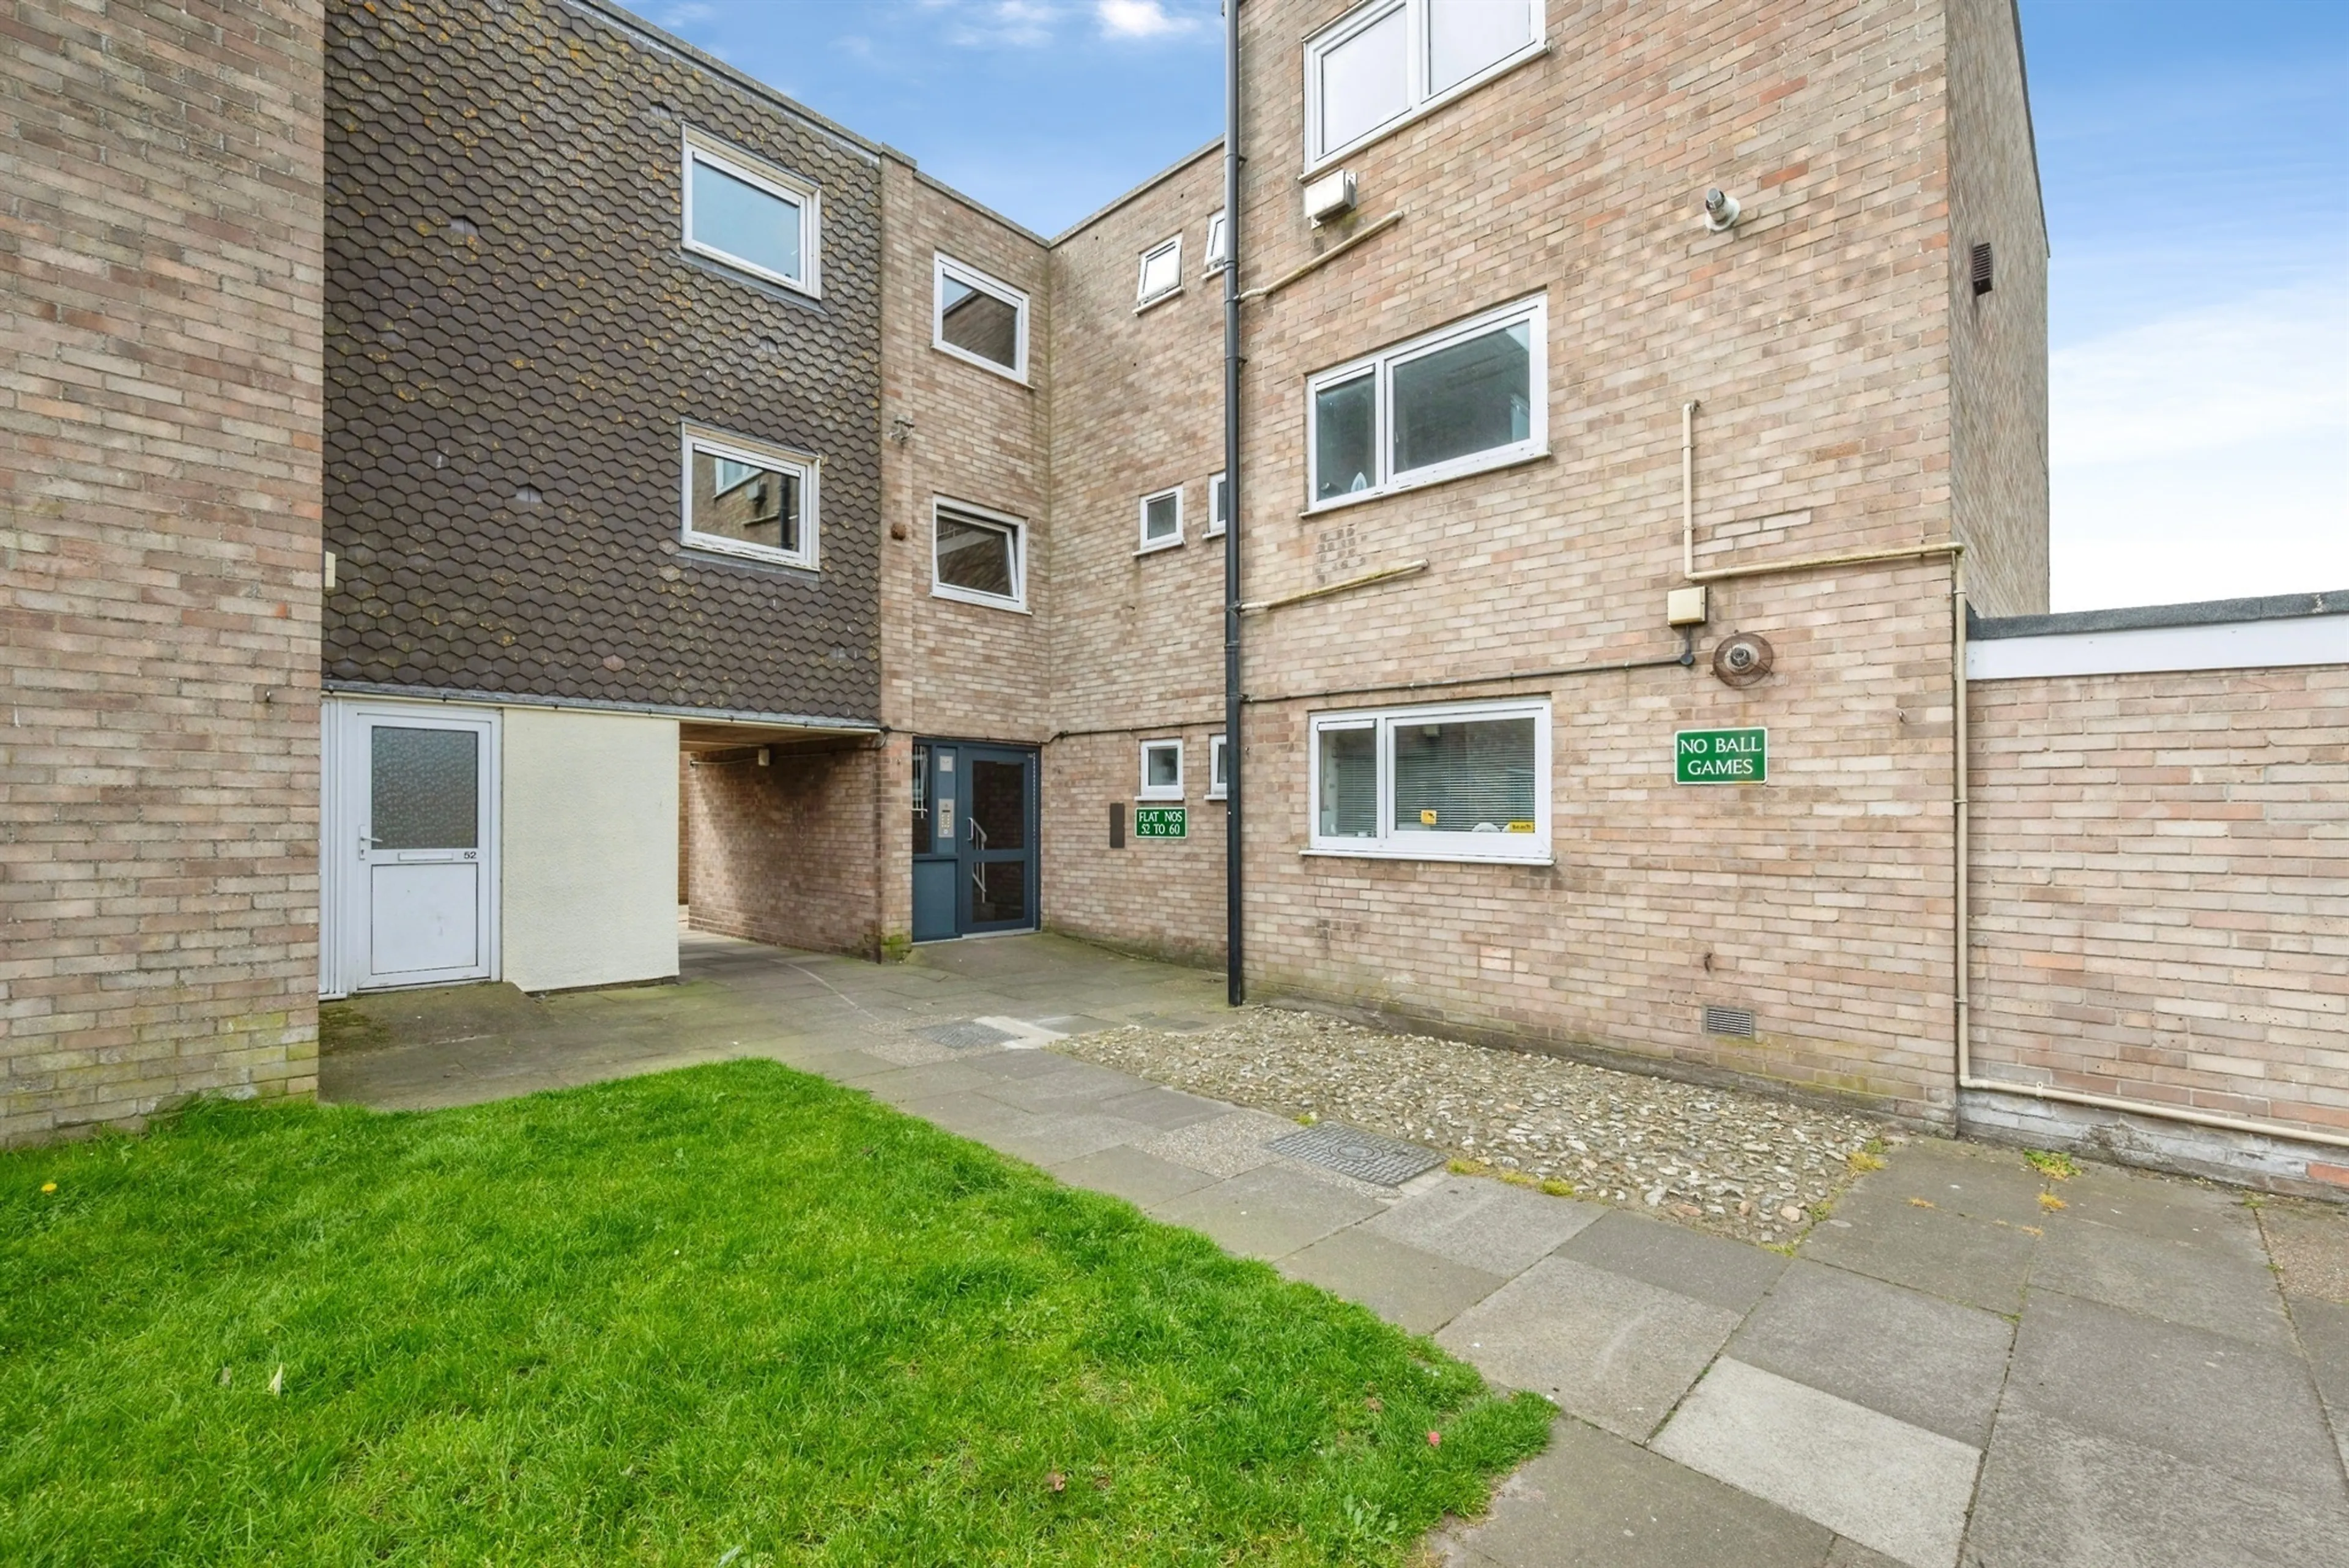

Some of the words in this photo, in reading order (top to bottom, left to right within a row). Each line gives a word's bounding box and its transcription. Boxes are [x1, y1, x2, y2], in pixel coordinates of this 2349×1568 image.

[1680, 738, 1707, 754] NO
[1715, 737, 1762, 753] BALL
[1687, 759, 1753, 775] GAMES
[1139, 811, 1159, 822] FLAT
[1164, 811, 1182, 822] NOS
[1141, 823, 1150, 834] 52
[1153, 823, 1165, 834] TO
[1169, 823, 1180, 834] 60
